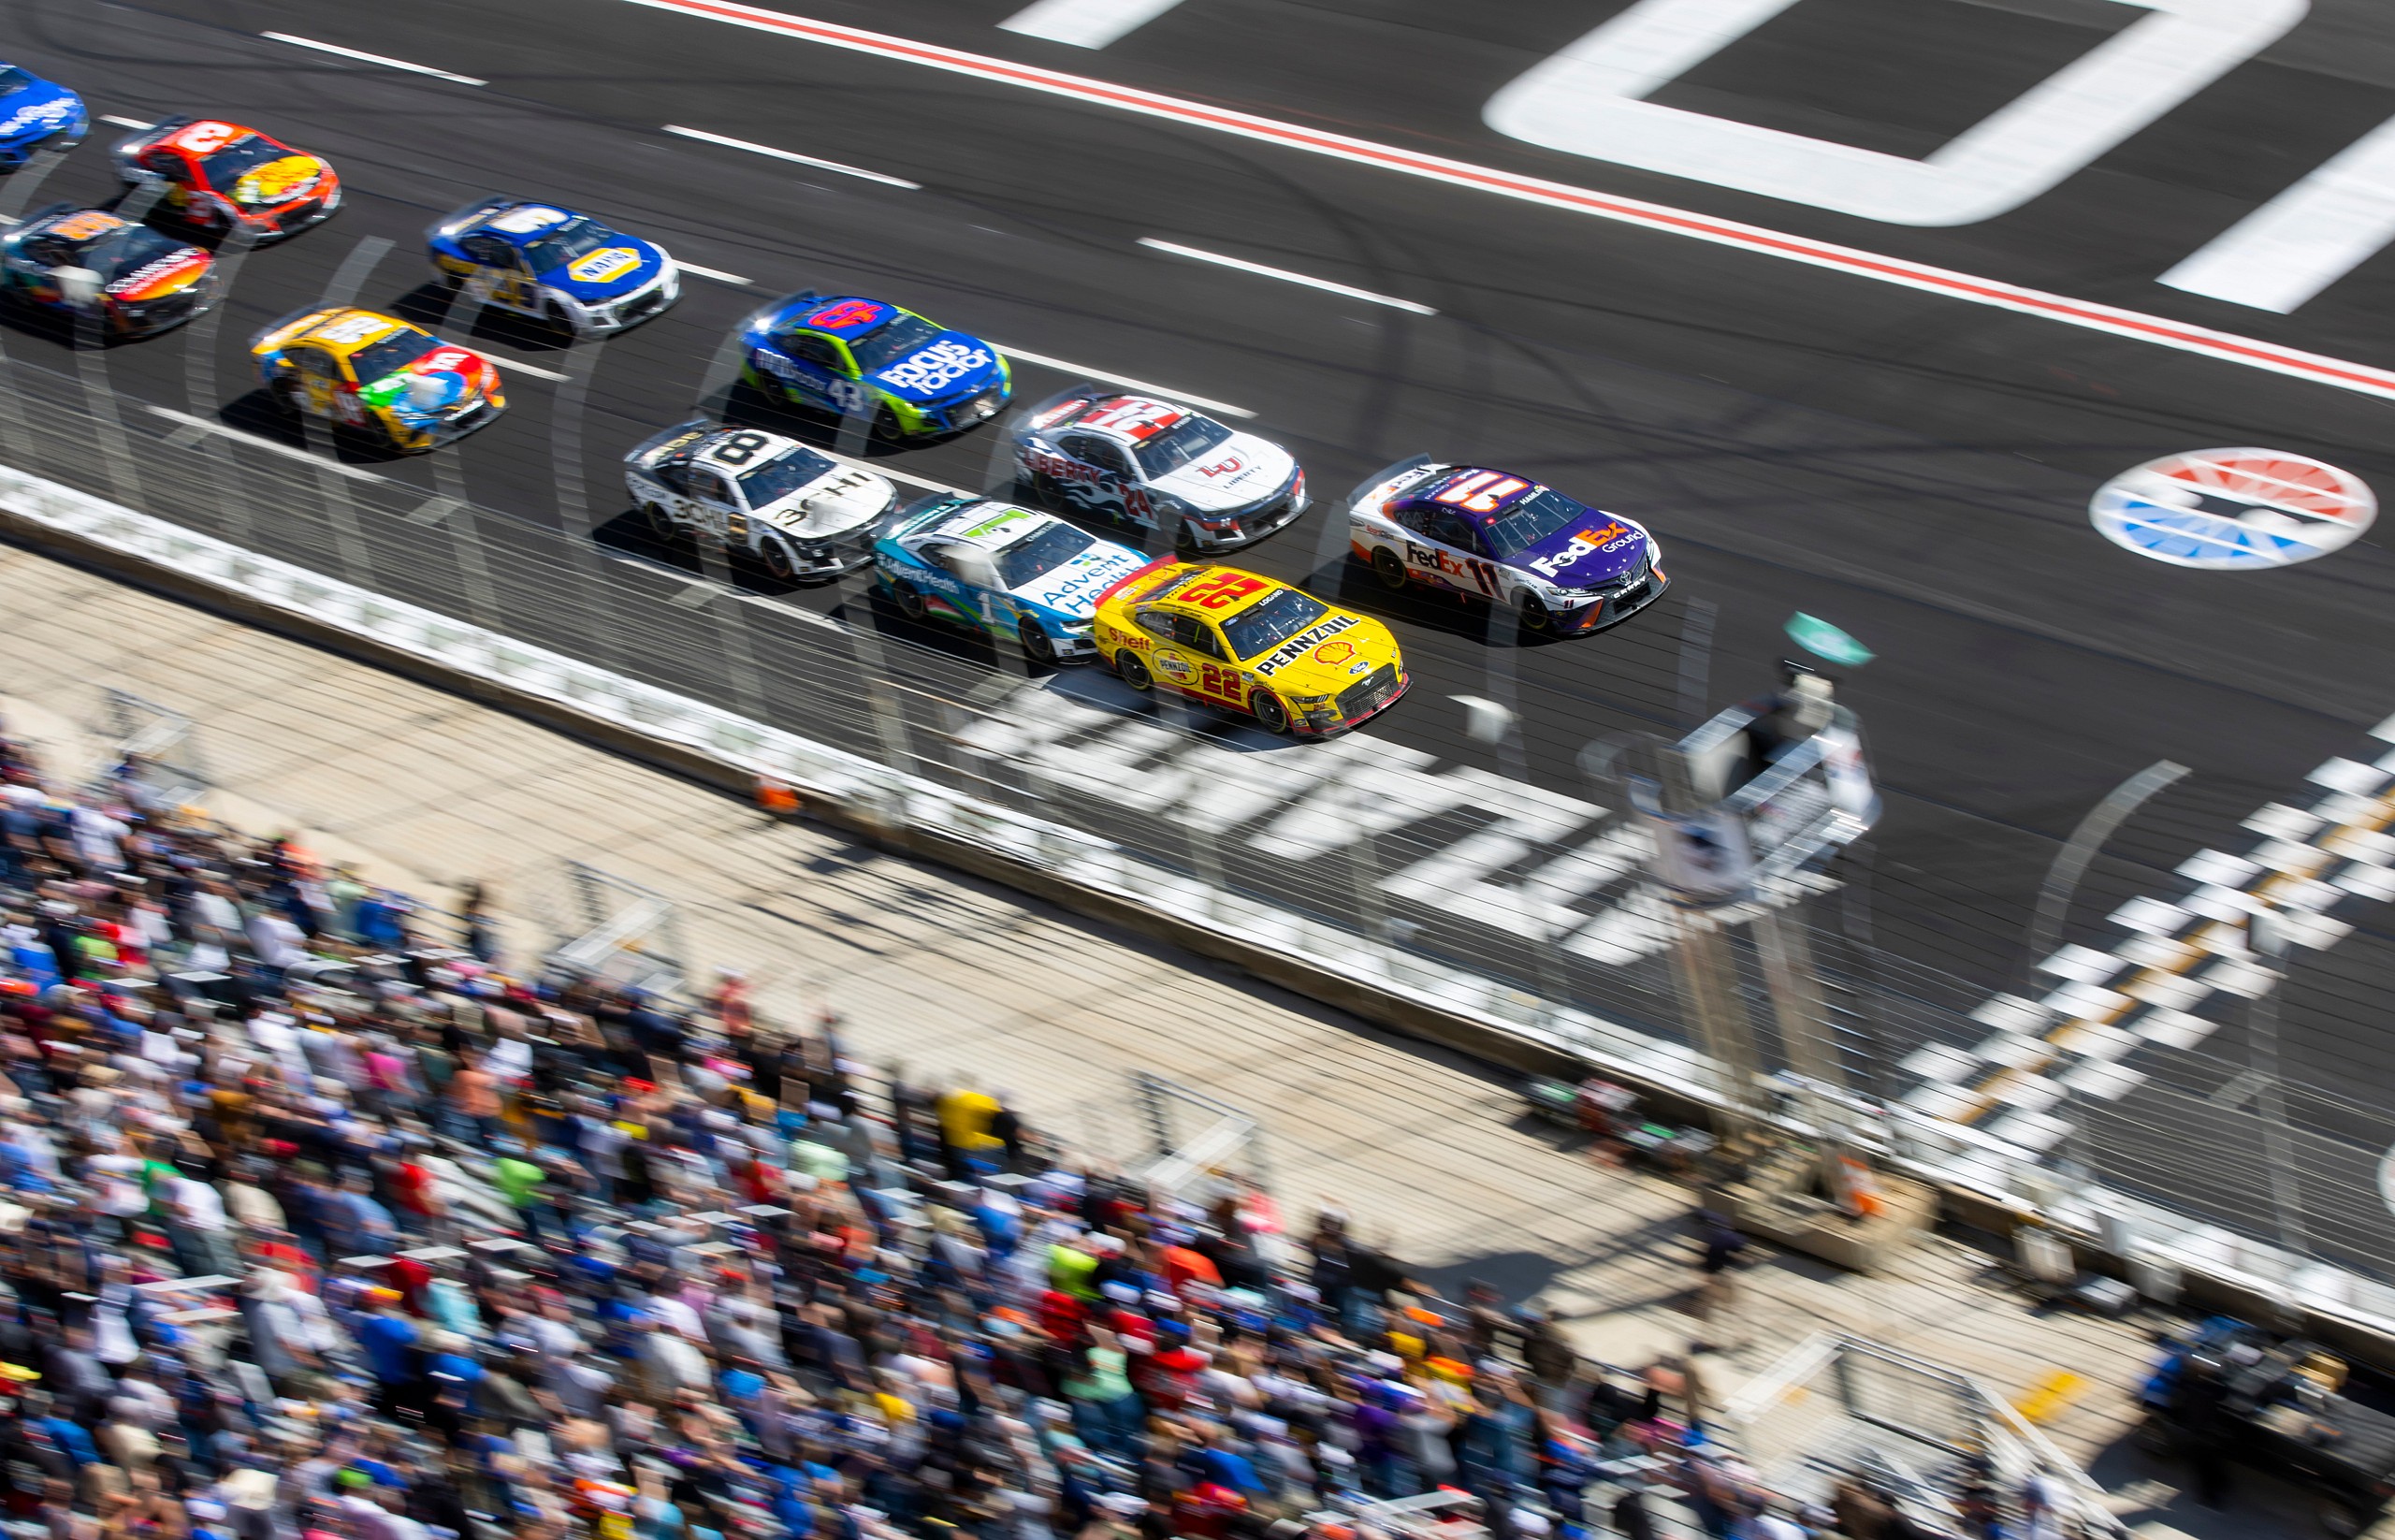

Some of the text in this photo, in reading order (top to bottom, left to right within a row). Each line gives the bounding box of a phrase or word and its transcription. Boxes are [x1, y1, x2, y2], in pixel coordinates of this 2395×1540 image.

[828, 379, 864, 412] 43
[714, 433, 769, 466] 8
[1224, 465, 1262, 489] LIBERTY
[1434, 472, 1530, 513] 11
[1118, 483, 1154, 520] 24
[1406, 540, 1465, 578] FedEx
[1529, 522, 1629, 577] FedEx
[1602, 530, 1644, 553] Ground
[1043, 554, 1129, 606] Advent
[1178, 572, 1270, 609] 22
[1259, 589, 1284, 606] LOGANO
[1465, 557, 1507, 602] 11
[1109, 628, 1152, 651] Shell
[1256, 616, 1359, 676] PENNZOIL
[1159, 659, 1192, 674] PENNZOIL
[1202, 662, 1241, 702] 22
